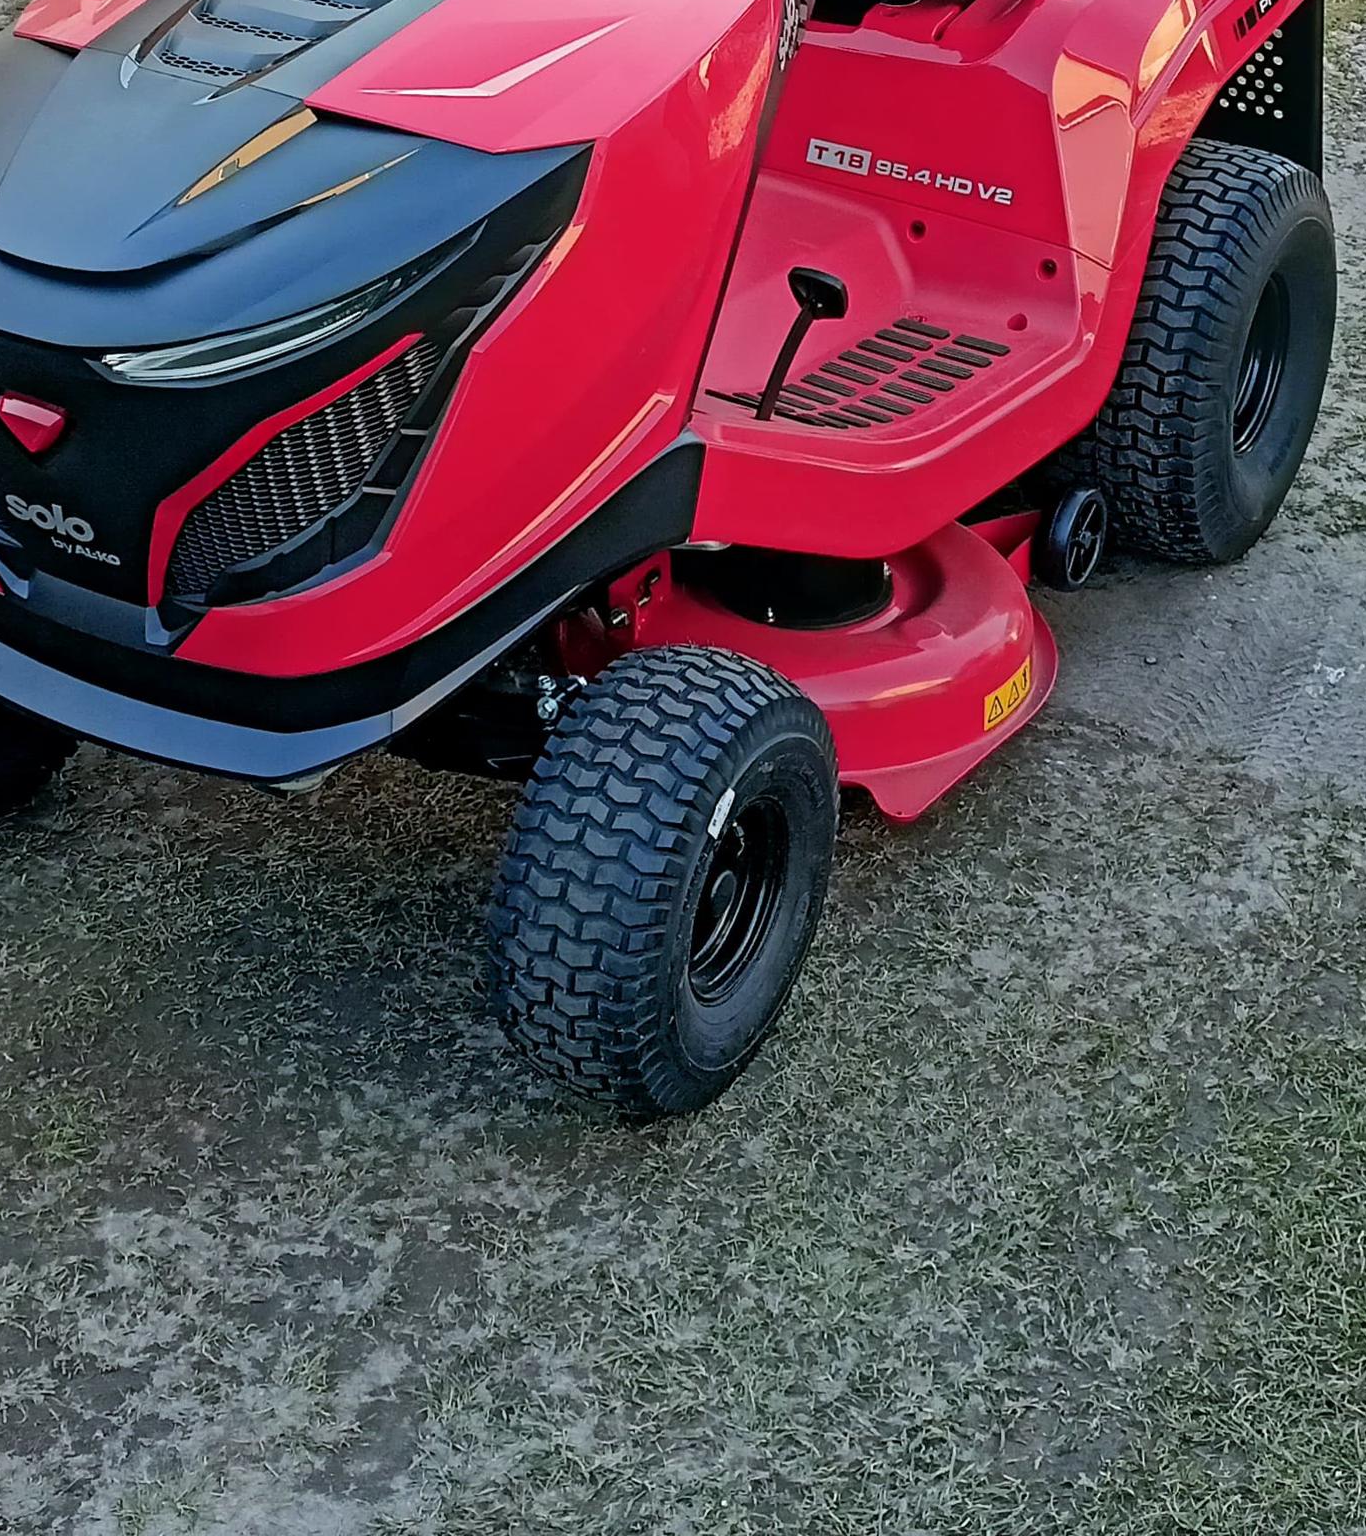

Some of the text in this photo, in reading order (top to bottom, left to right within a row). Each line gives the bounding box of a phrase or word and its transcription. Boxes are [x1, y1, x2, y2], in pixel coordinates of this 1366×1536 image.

[875, 159, 931, 185] 95.4
[935, 173, 973, 195] HD
[977, 182, 1013, 205] V2
[51, 536, 72, 554] by
